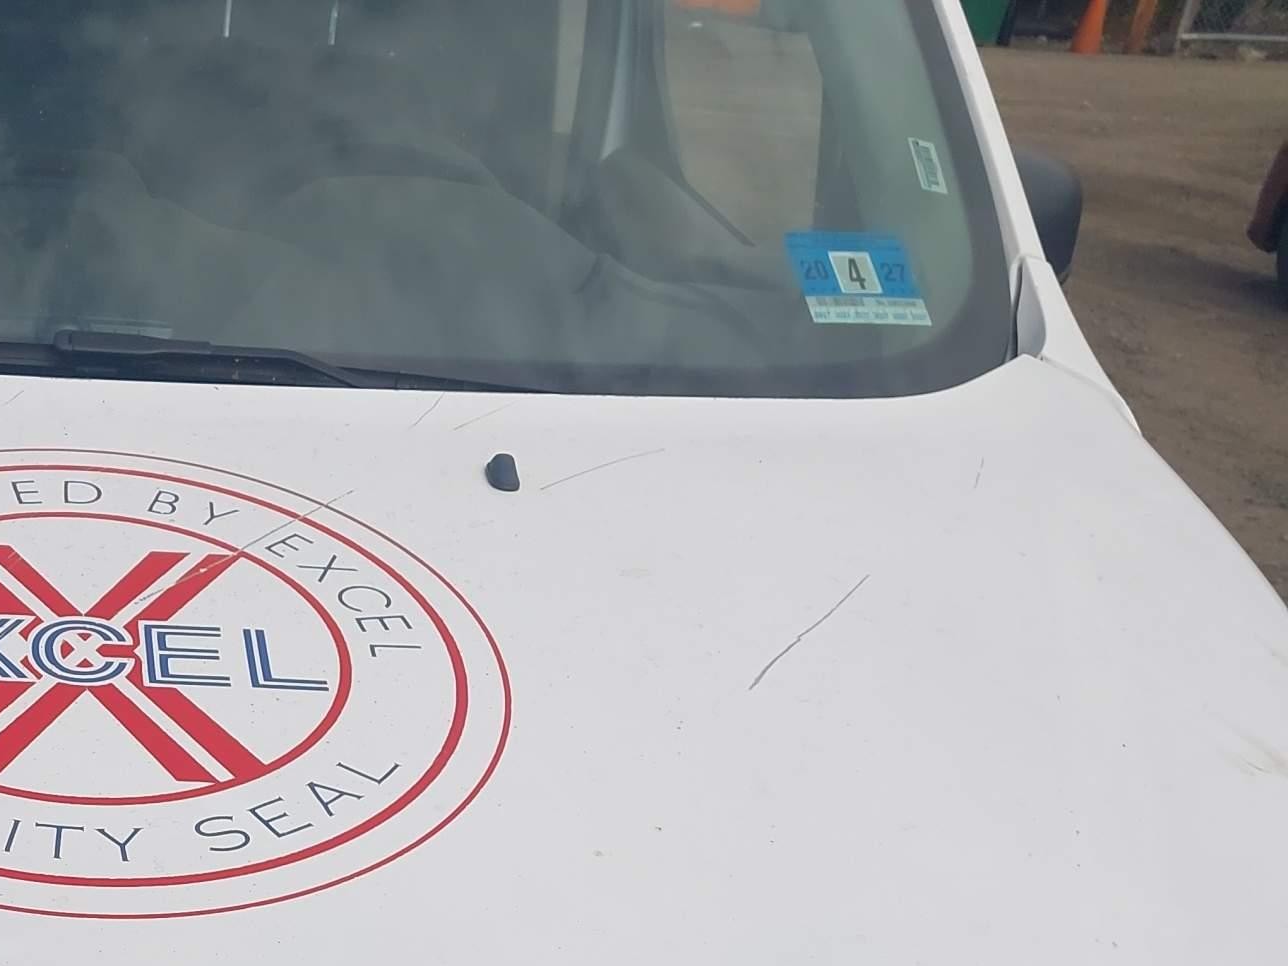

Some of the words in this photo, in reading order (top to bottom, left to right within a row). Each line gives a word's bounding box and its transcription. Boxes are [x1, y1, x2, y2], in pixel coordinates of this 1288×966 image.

[800, 260, 828, 281] 20
[847, 257, 867, 290] 4
[880, 263, 905, 283] 27
[147, 489, 239, 526] BY
[264, 533, 422, 658] EXCEL
[194, 762, 402, 852] SEAL
